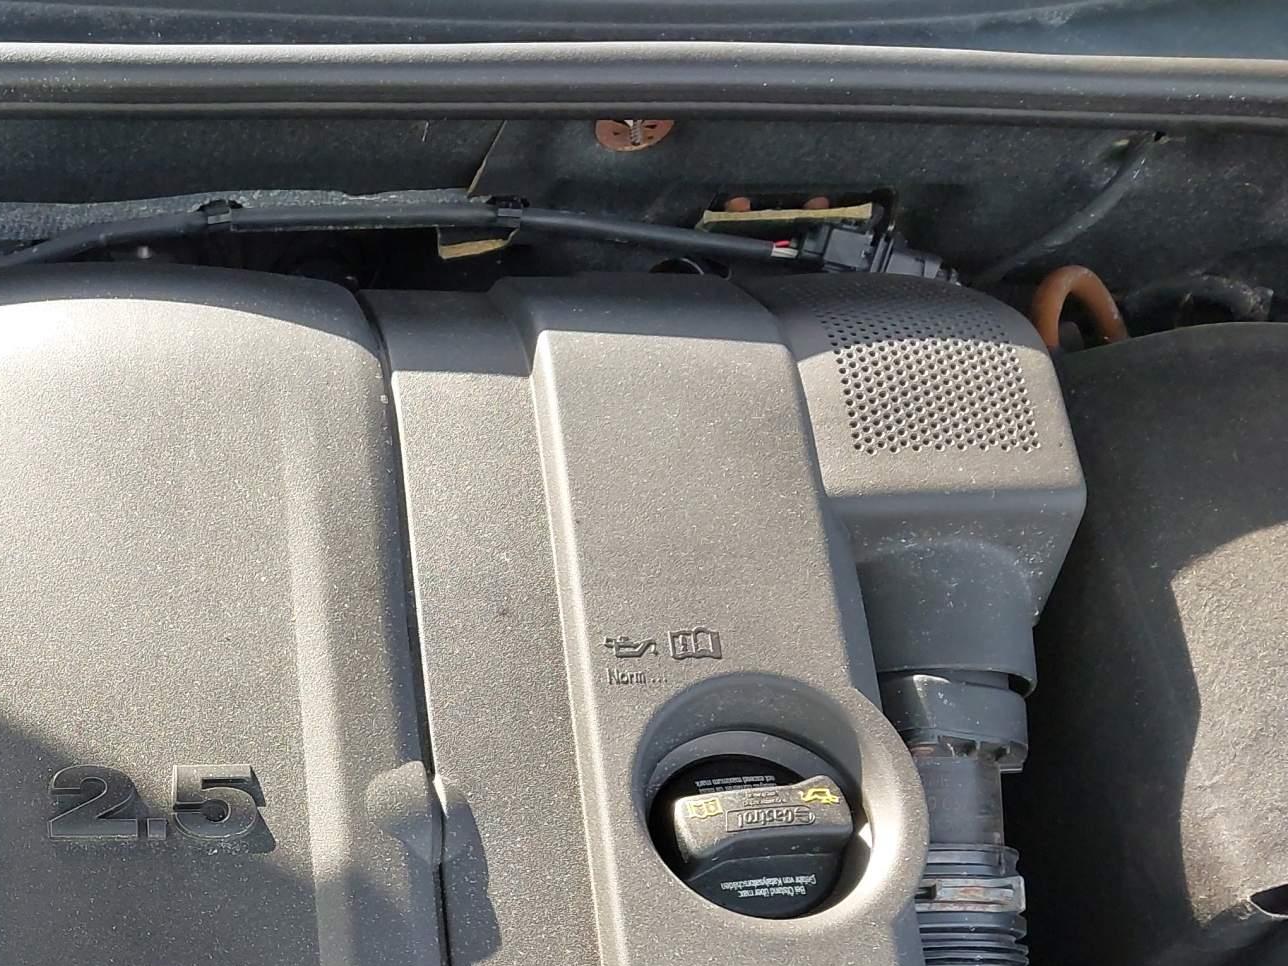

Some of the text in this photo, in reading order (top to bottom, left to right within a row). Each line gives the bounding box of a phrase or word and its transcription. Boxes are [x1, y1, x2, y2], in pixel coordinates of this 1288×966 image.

[607, 668, 646, 685] Norm
[47, 764, 268, 841] 2.5
[737, 807, 794, 828] Castrol
